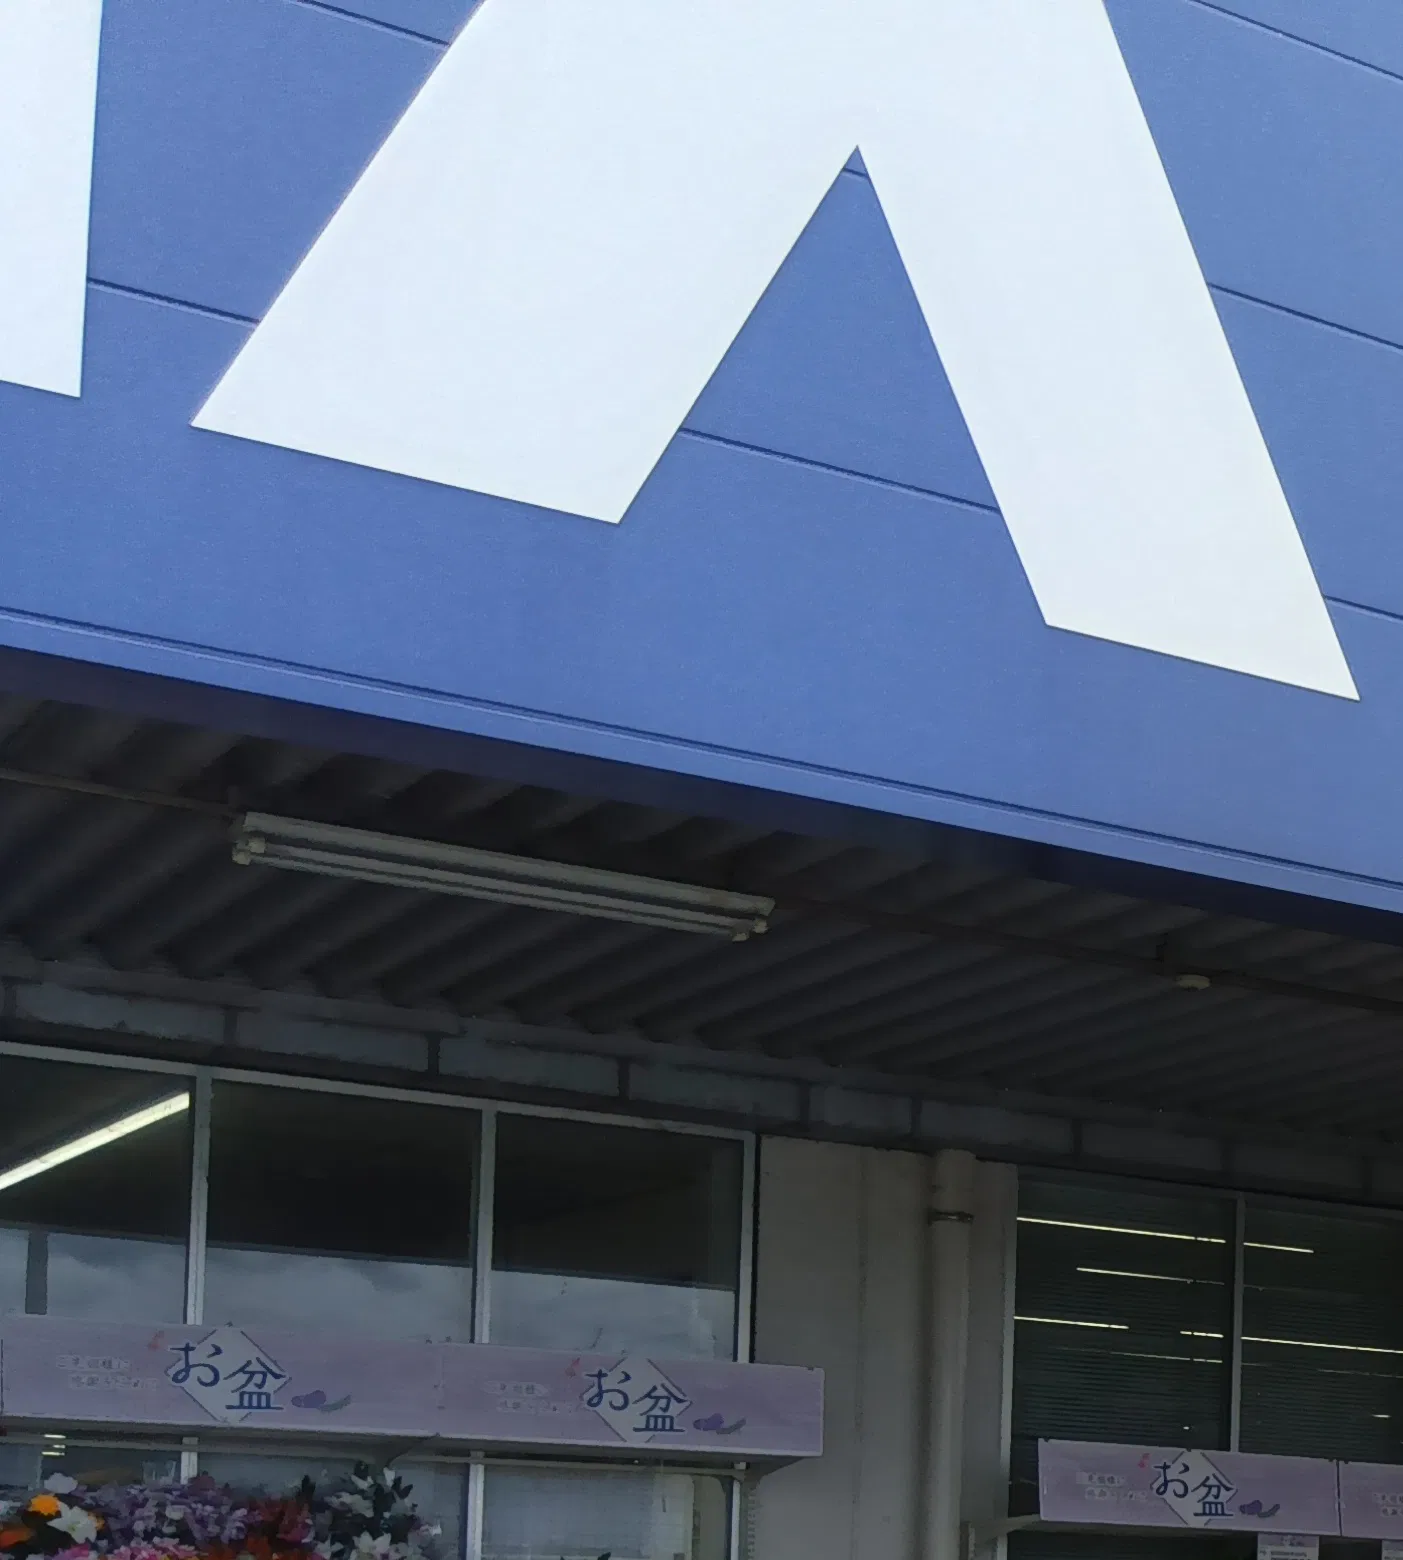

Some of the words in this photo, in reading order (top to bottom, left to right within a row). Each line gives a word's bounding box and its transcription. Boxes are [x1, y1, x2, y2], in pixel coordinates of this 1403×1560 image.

[170, 1342, 290, 1412] お盆
[585, 1367, 691, 1434] お盆
[1153, 1461, 1237, 1517] お盆
